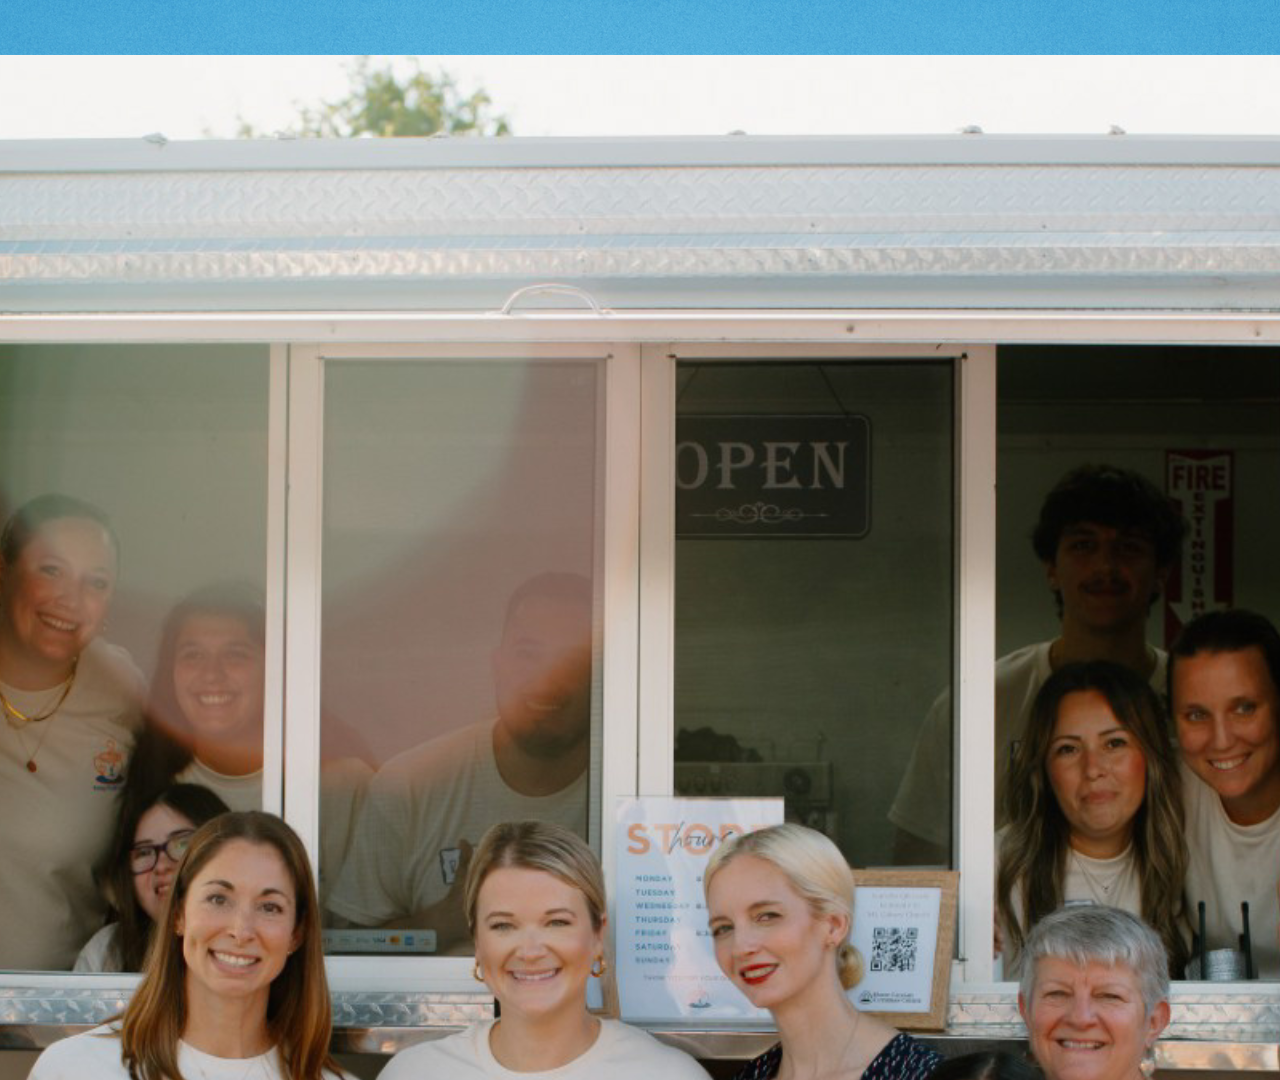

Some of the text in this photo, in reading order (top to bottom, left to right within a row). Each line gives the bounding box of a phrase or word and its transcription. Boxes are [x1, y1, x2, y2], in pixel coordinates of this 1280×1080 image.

[676, 441, 849, 490] OPEN
[1172, 464, 1227, 491] FIRE
[1191, 491, 1206, 621] EXTINGUISH
[635, 888, 676, 897] TUESDAY
[634, 943, 680, 951] SATURD
